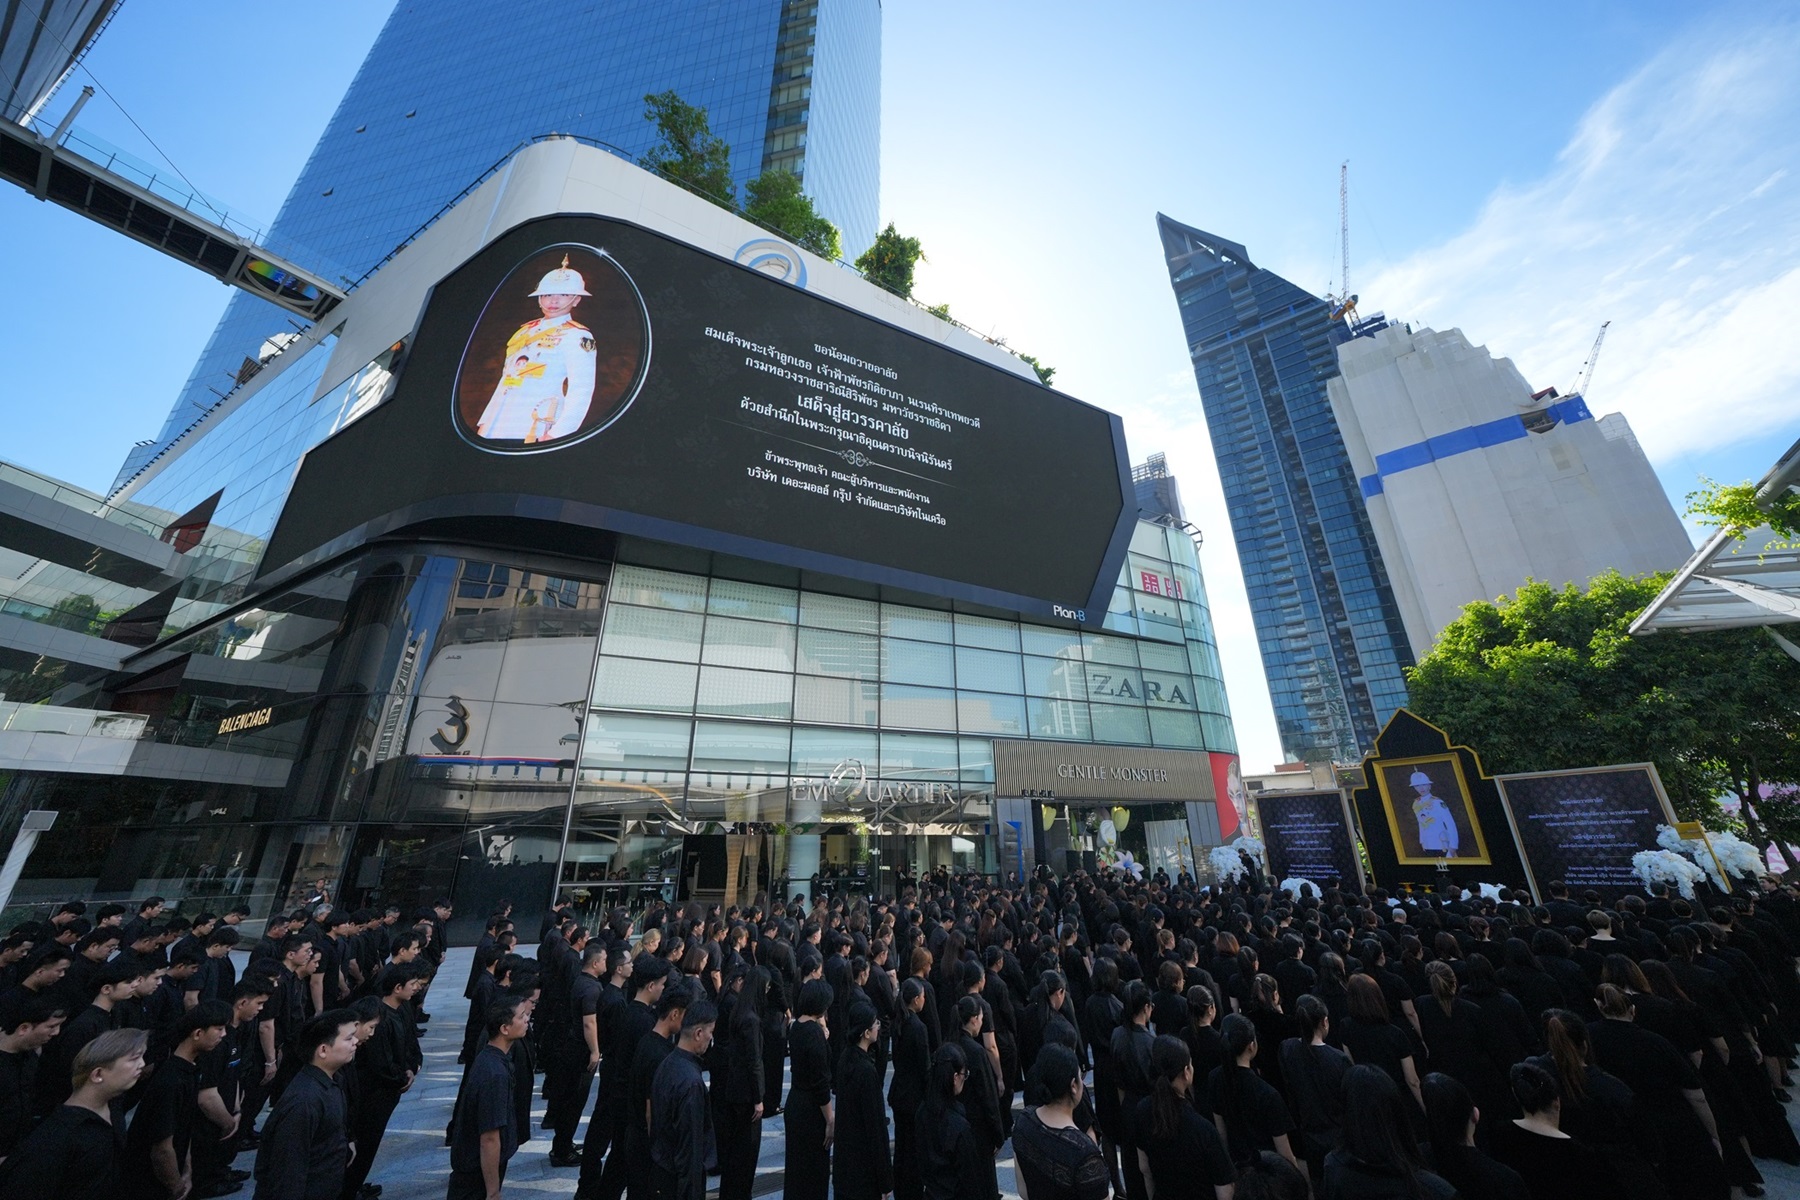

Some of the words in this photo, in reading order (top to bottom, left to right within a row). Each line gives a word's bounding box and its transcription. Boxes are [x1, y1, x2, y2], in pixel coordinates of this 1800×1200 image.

[704, 325, 812, 371] สมเด็จพระเจ้าลูกเธอ
[907, 395, 981, 429] นเรนทิราเทพยวดี
[814, 342, 898, 380] ขอน้อมถวายอาลัย
[745, 356, 878, 408] กรมหลวงราชสาริณีสิริพัชร
[882, 402, 951, 432] มหาวัชรราชธิดา
[797, 394, 909, 440] เสด็จสู่สวรรคาลัย
[747, 466, 777, 483] บริษัท
[782, 477, 829, 496] เดอะมอลล์
[856, 494, 946, 526] จำกัดและบริษัทในเครือ
[764, 449, 828, 476] ข้าพระพุทธเจ้า
[832, 470, 930, 504] คณะผู้บริหารและพนักงาน
[1093, 674, 1190, 704] ZARA
[218, 707, 272, 734] BALENCIAGA
[1058, 764, 1106, 779] GENTLE
[1110, 767, 1167, 782] MONSTER
